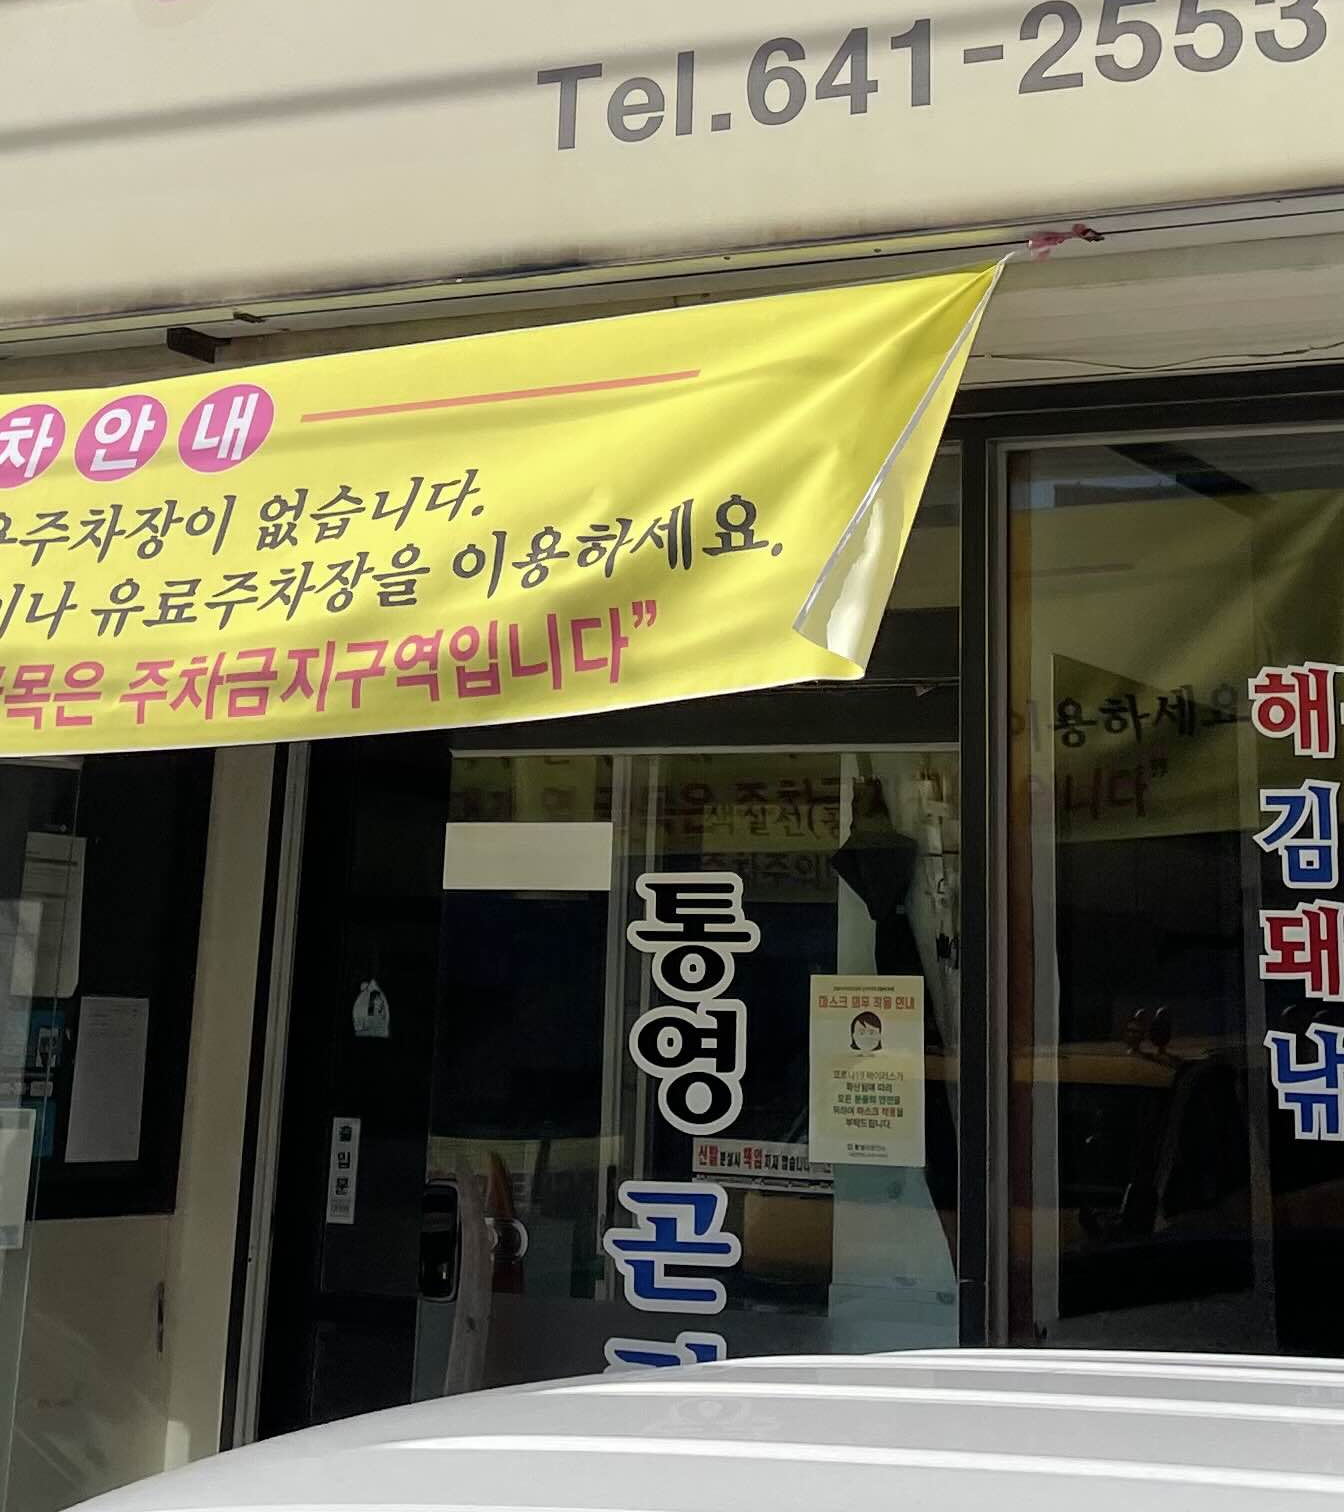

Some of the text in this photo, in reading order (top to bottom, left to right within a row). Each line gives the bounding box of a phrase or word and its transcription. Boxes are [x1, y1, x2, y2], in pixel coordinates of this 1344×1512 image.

[91, 542, 431, 638] 유료주차장을
[452, 494, 783, 598] 이용하세요.
[256, 468, 486, 551] 없습니다.
[627, 872, 761, 1135] 통영
[603, 1180, 742, 1372] 곤
